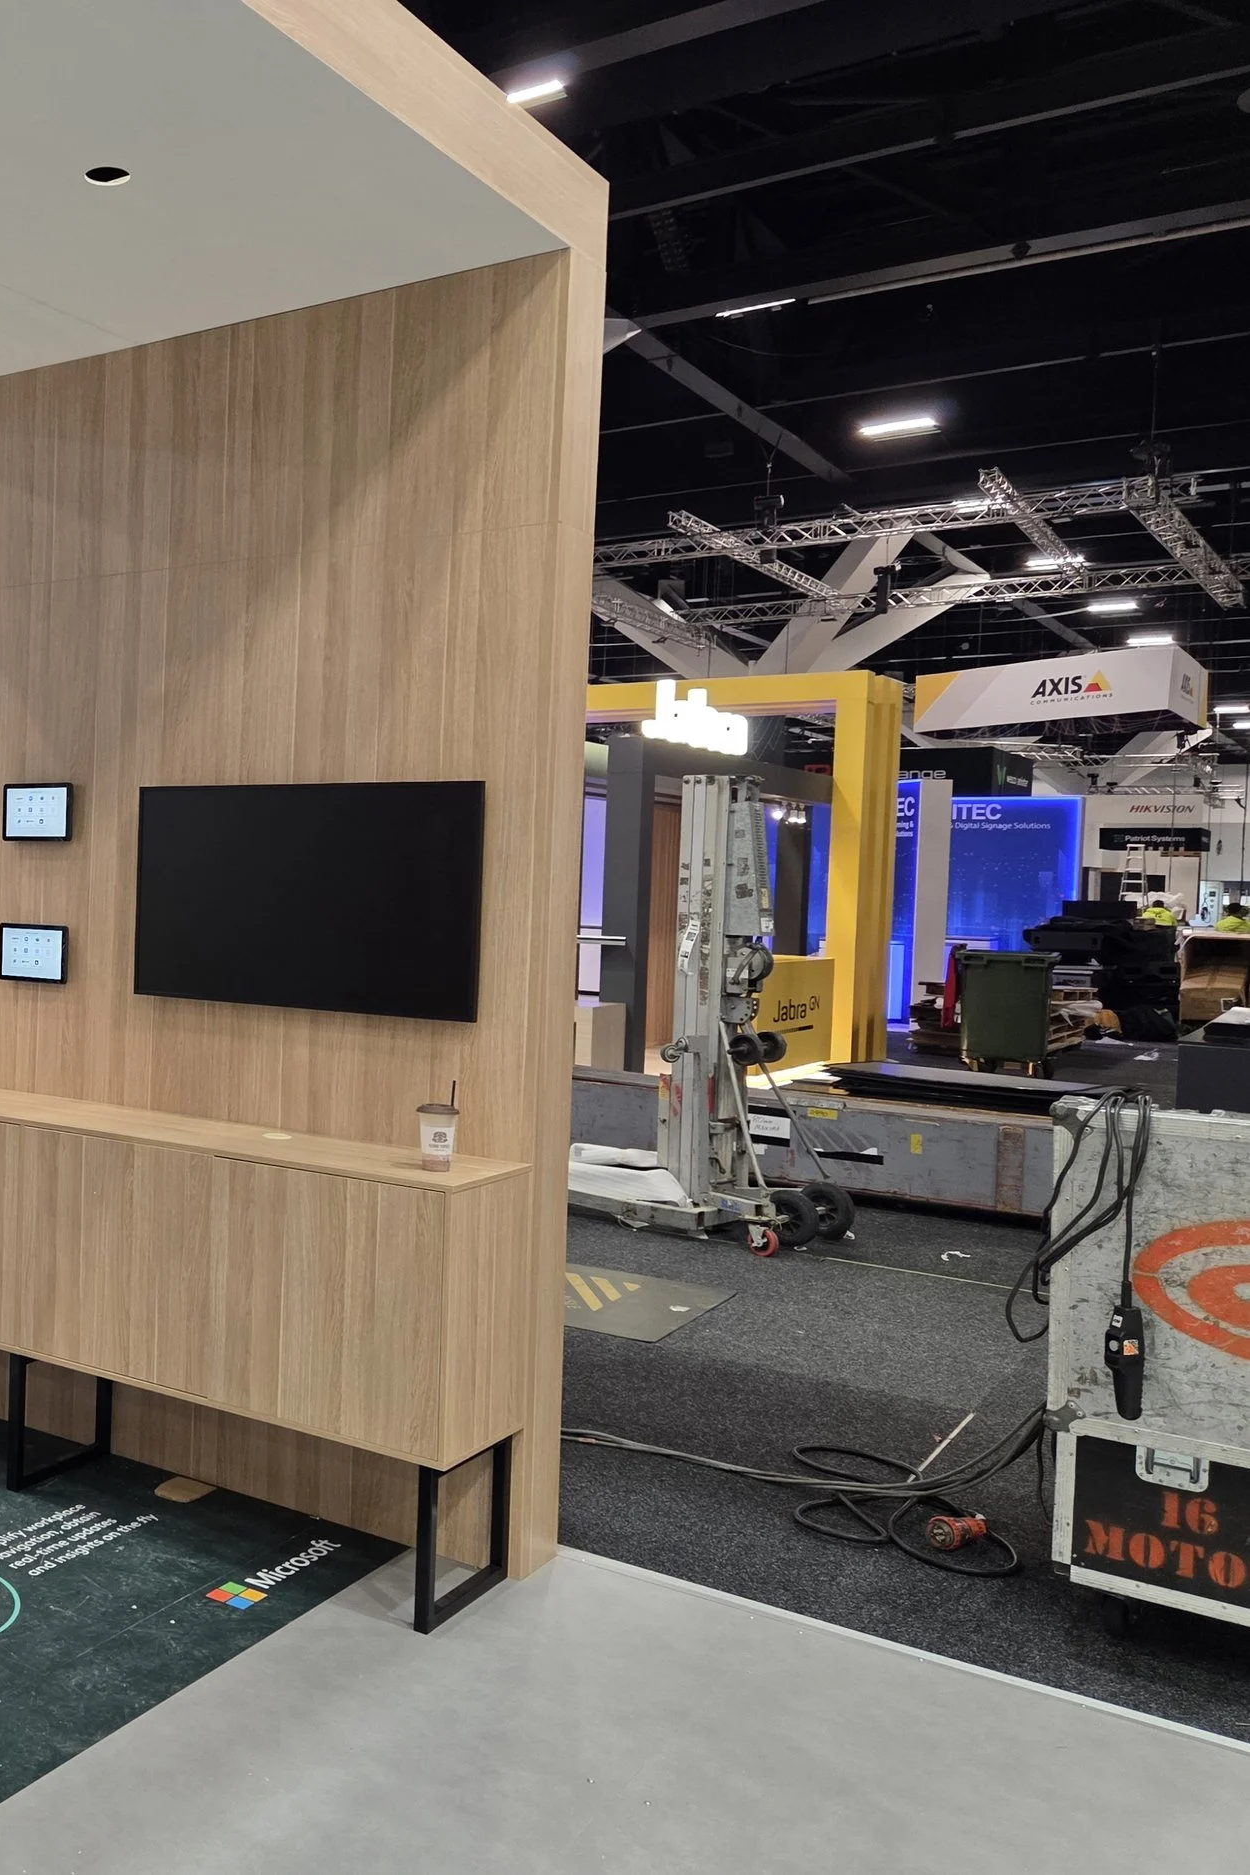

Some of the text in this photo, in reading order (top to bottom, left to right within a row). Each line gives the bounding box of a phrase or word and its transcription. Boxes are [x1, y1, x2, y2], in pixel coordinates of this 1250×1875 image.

[1030, 692, 1114, 706] COMMUNICATIONS
[1031, 675, 1083, 699] AXIS
[952, 803, 1002, 820] ITEC
[1129, 804, 1195, 813] HIKVISION
[955, 822, 980, 831] Digital
[981, 822, 1013, 831] Signage
[1013, 822, 1051, 830] Solutions
[1125, 834, 1186, 843] Patriot Systems
[773, 995, 820, 1023] Jabra GN
[23, 1503, 86, 1533] workplace
[60, 1511, 101, 1531] obtain
[1161, 1491, 1219, 1535] 16
[8, 1517, 118, 1570] real-time updates
[28, 1513, 159, 1577] and insights on the fly
[1084, 1519, 1247, 1588] MOTO
[244, 1538, 342, 1589] Microsoft
